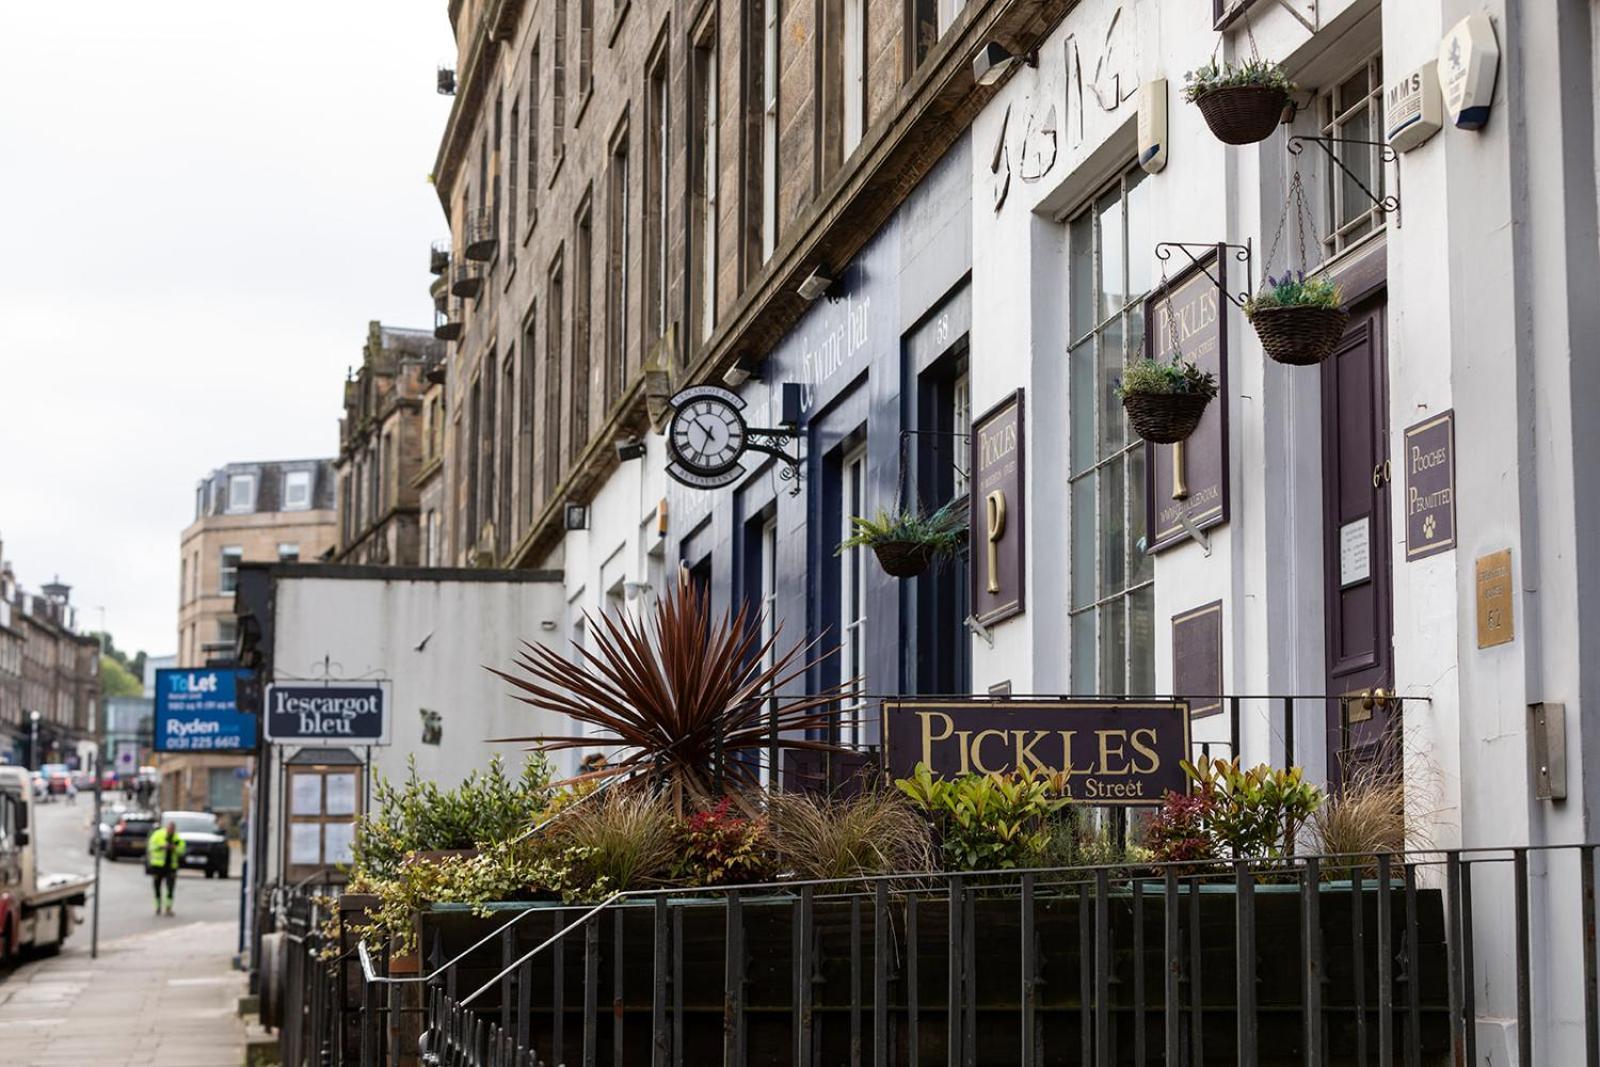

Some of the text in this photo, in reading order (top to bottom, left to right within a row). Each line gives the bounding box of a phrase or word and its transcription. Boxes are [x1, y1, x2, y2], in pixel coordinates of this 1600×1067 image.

[814, 319, 845, 387] wine
[847, 292, 870, 357] bar
[936, 313, 949, 345] 58
[980, 421, 1016, 471] PICKLES
[1411, 446, 1446, 475] POOCHES
[1373, 459, 1391, 487] 60
[1409, 486, 1452, 516] PERMITTED
[275, 692, 378, 719] l'escargot
[166, 718, 219, 736] Ryden
[298, 712, 353, 734] bleu
[914, 711, 1161, 776] PICKLES
[1085, 777, 1144, 798] Street
